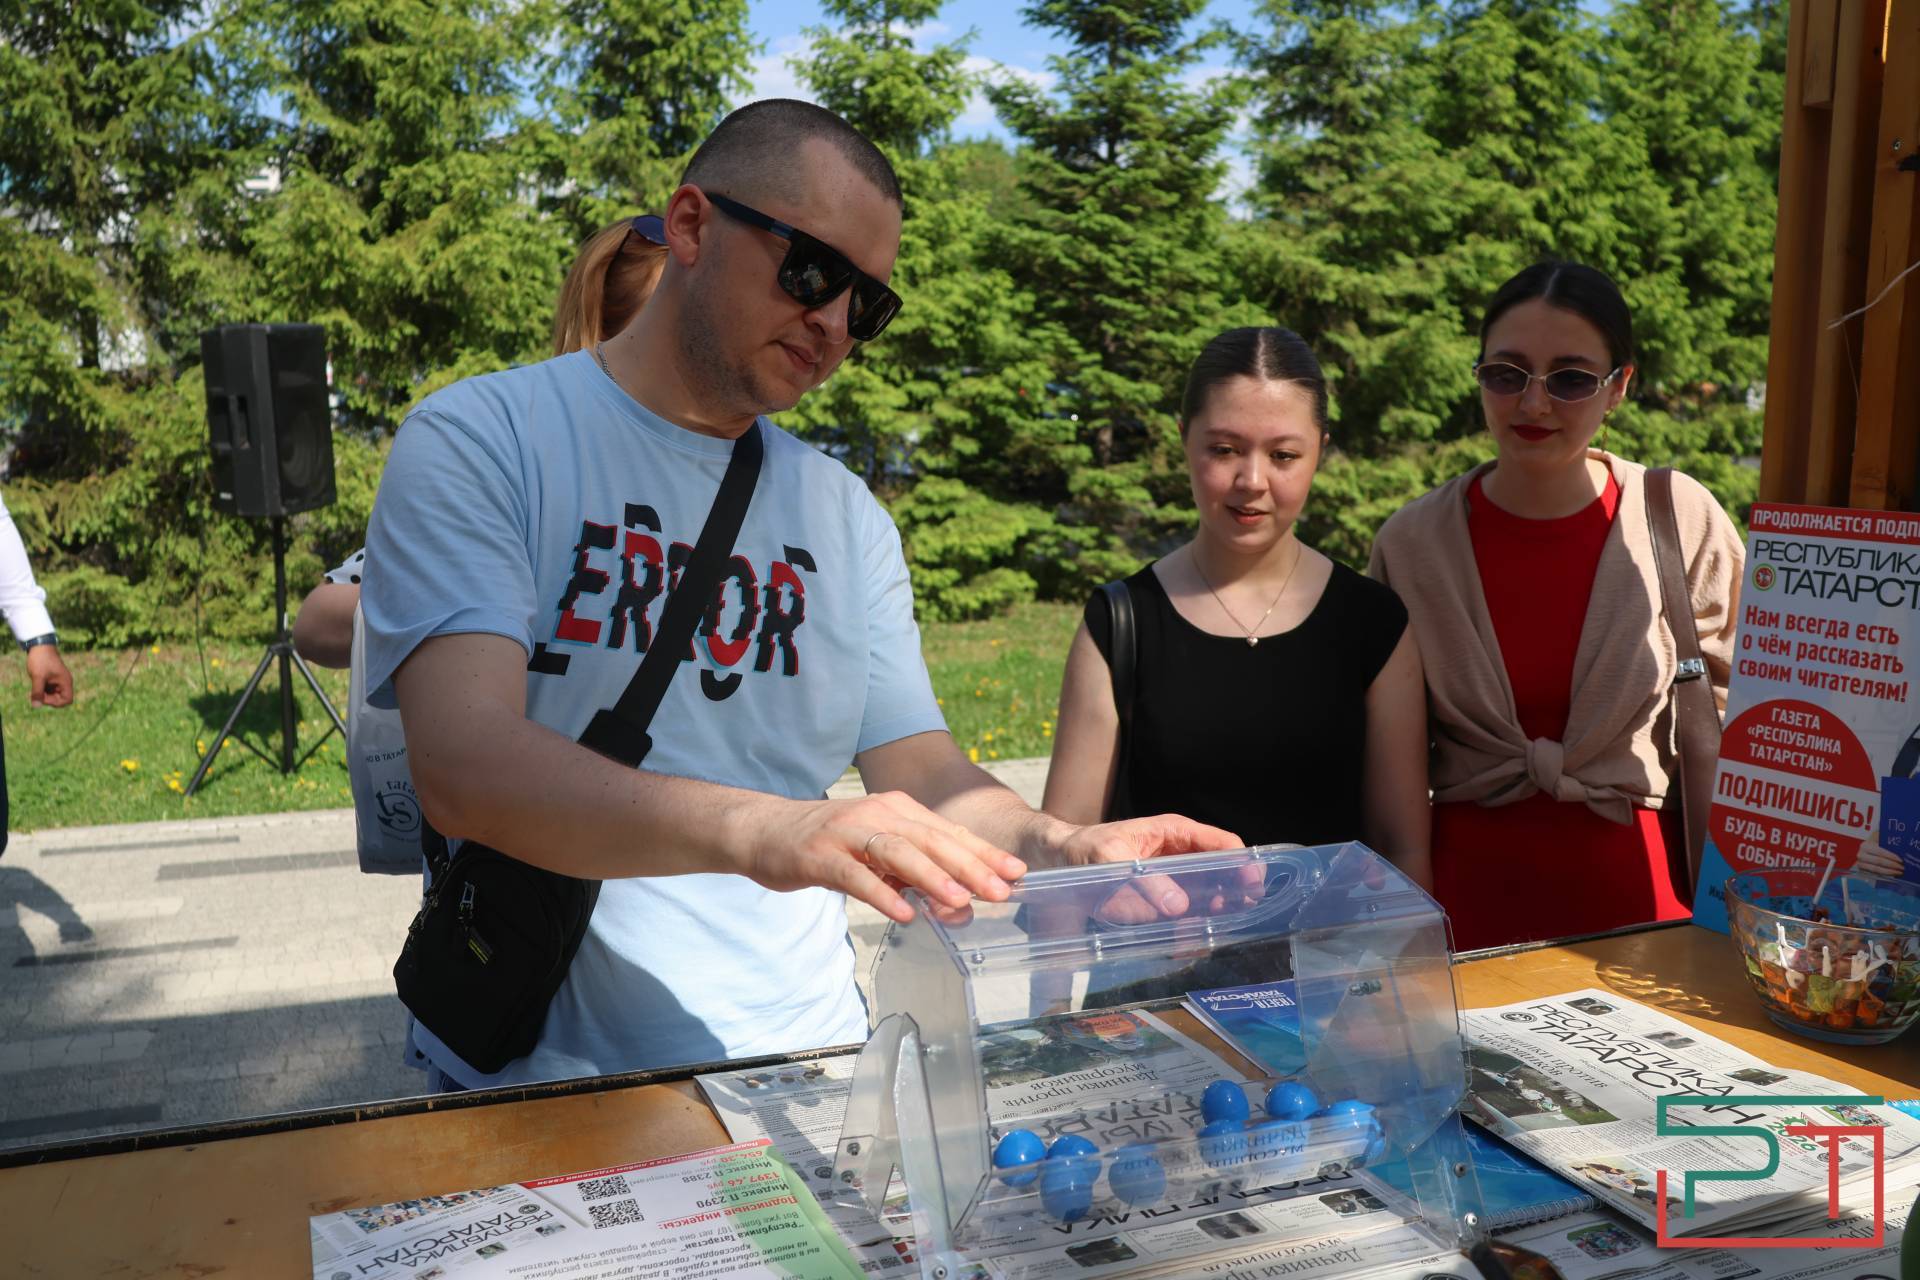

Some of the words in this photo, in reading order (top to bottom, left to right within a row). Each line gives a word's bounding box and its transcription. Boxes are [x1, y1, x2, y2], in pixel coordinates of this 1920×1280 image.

[1753, 509, 1872, 534] ПРОДОЛЖАЕТСЯ
[1778, 566, 1920, 610] ТАТАРСТ
[1745, 605, 1780, 628] Нам
[1785, 614, 1850, 640] всегда
[1856, 623, 1899, 645] есть
[1742, 634, 1752, 650] о
[1758, 633, 1791, 656] чём
[1796, 641, 1904, 674] рассказать
[1739, 659, 1792, 683] своим
[1798, 669, 1908, 703] читателям!
[1771, 708, 1820, 730] ГАЗЕТА
[1747, 724, 1842, 755] «РЕСПУБЛИКА
[1749, 742, 1833, 772] ТАТАРСТАН»
[1718, 772, 1874, 831] ПОДПИШИСЬ!
[1725, 816, 1766, 841] БУДЬ
[1771, 829, 1781, 845] В
[1785, 831, 1837, 859] КУРСЕ
[1527, 1004, 1734, 1097] РЕСПУБЛИКА
[1030, 1061, 1145, 1091] мусорщиков
[1077, 1071, 1158, 1094] Дачники
[726, 1160, 771, 1174] Индекс
[695, 1196, 725, 1207] 2390
[741, 1183, 788, 1197] Индекс
[656, 1212, 721, 1229] индексы:
[723, 1196, 798, 1215] Подписные
[357, 1209, 521, 1274] ТАТАРСТАН
[401, 1210, 554, 1267] РЕСПУБЛИКА
[720, 1251, 761, 1263] события
[1257, 1247, 1363, 1278] Дачники
